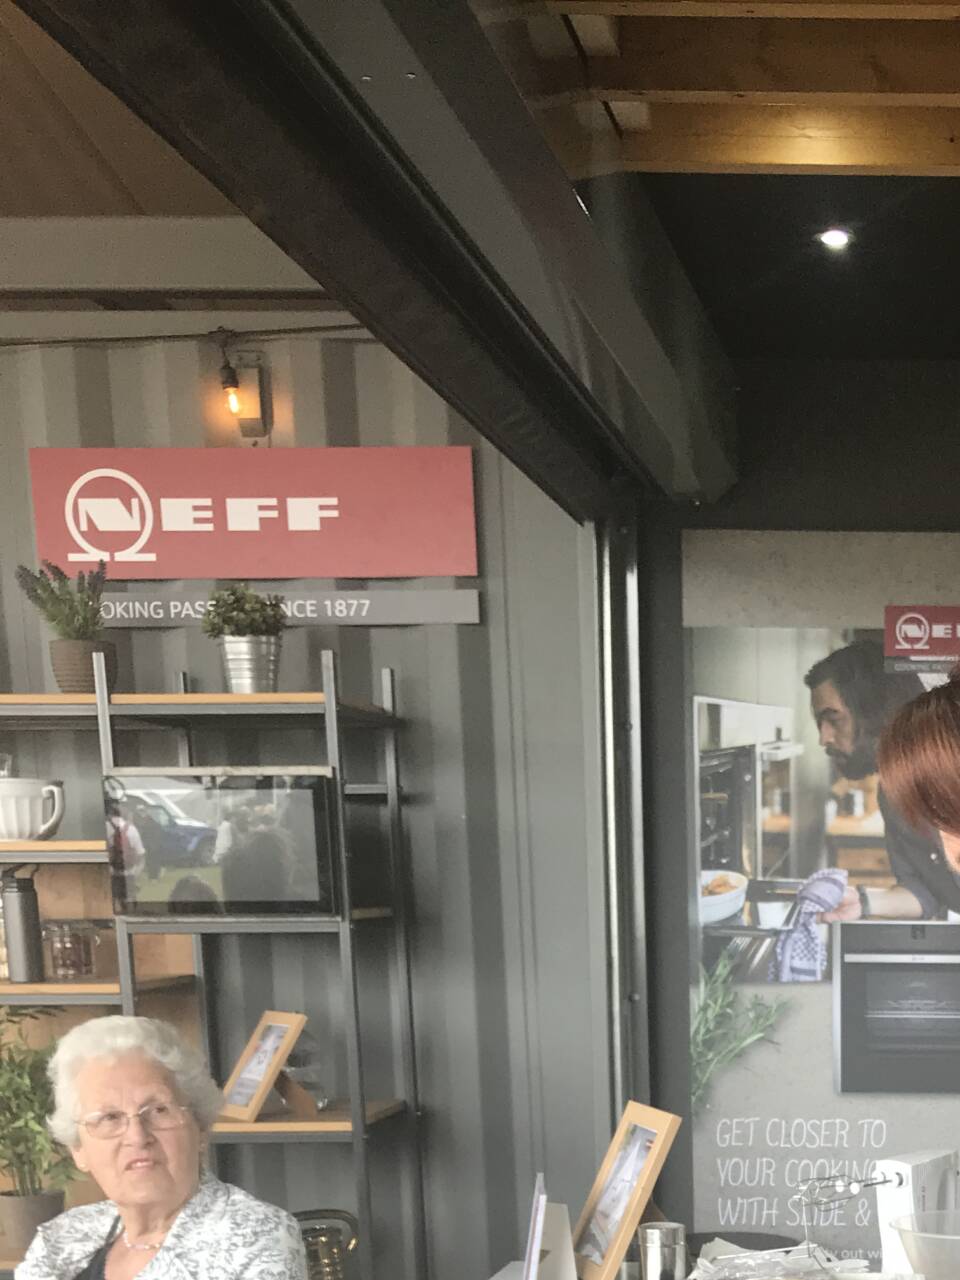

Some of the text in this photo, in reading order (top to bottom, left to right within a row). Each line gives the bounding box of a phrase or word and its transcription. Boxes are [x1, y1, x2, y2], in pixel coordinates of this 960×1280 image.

[100, 601, 164, 619] OKING
[323, 599, 372, 617] 1877
[716, 1116, 887, 1148] GET CLOSER TO
[716, 1157, 776, 1188] YOUR
[717, 1196, 871, 1227] WITH SLIDE &
